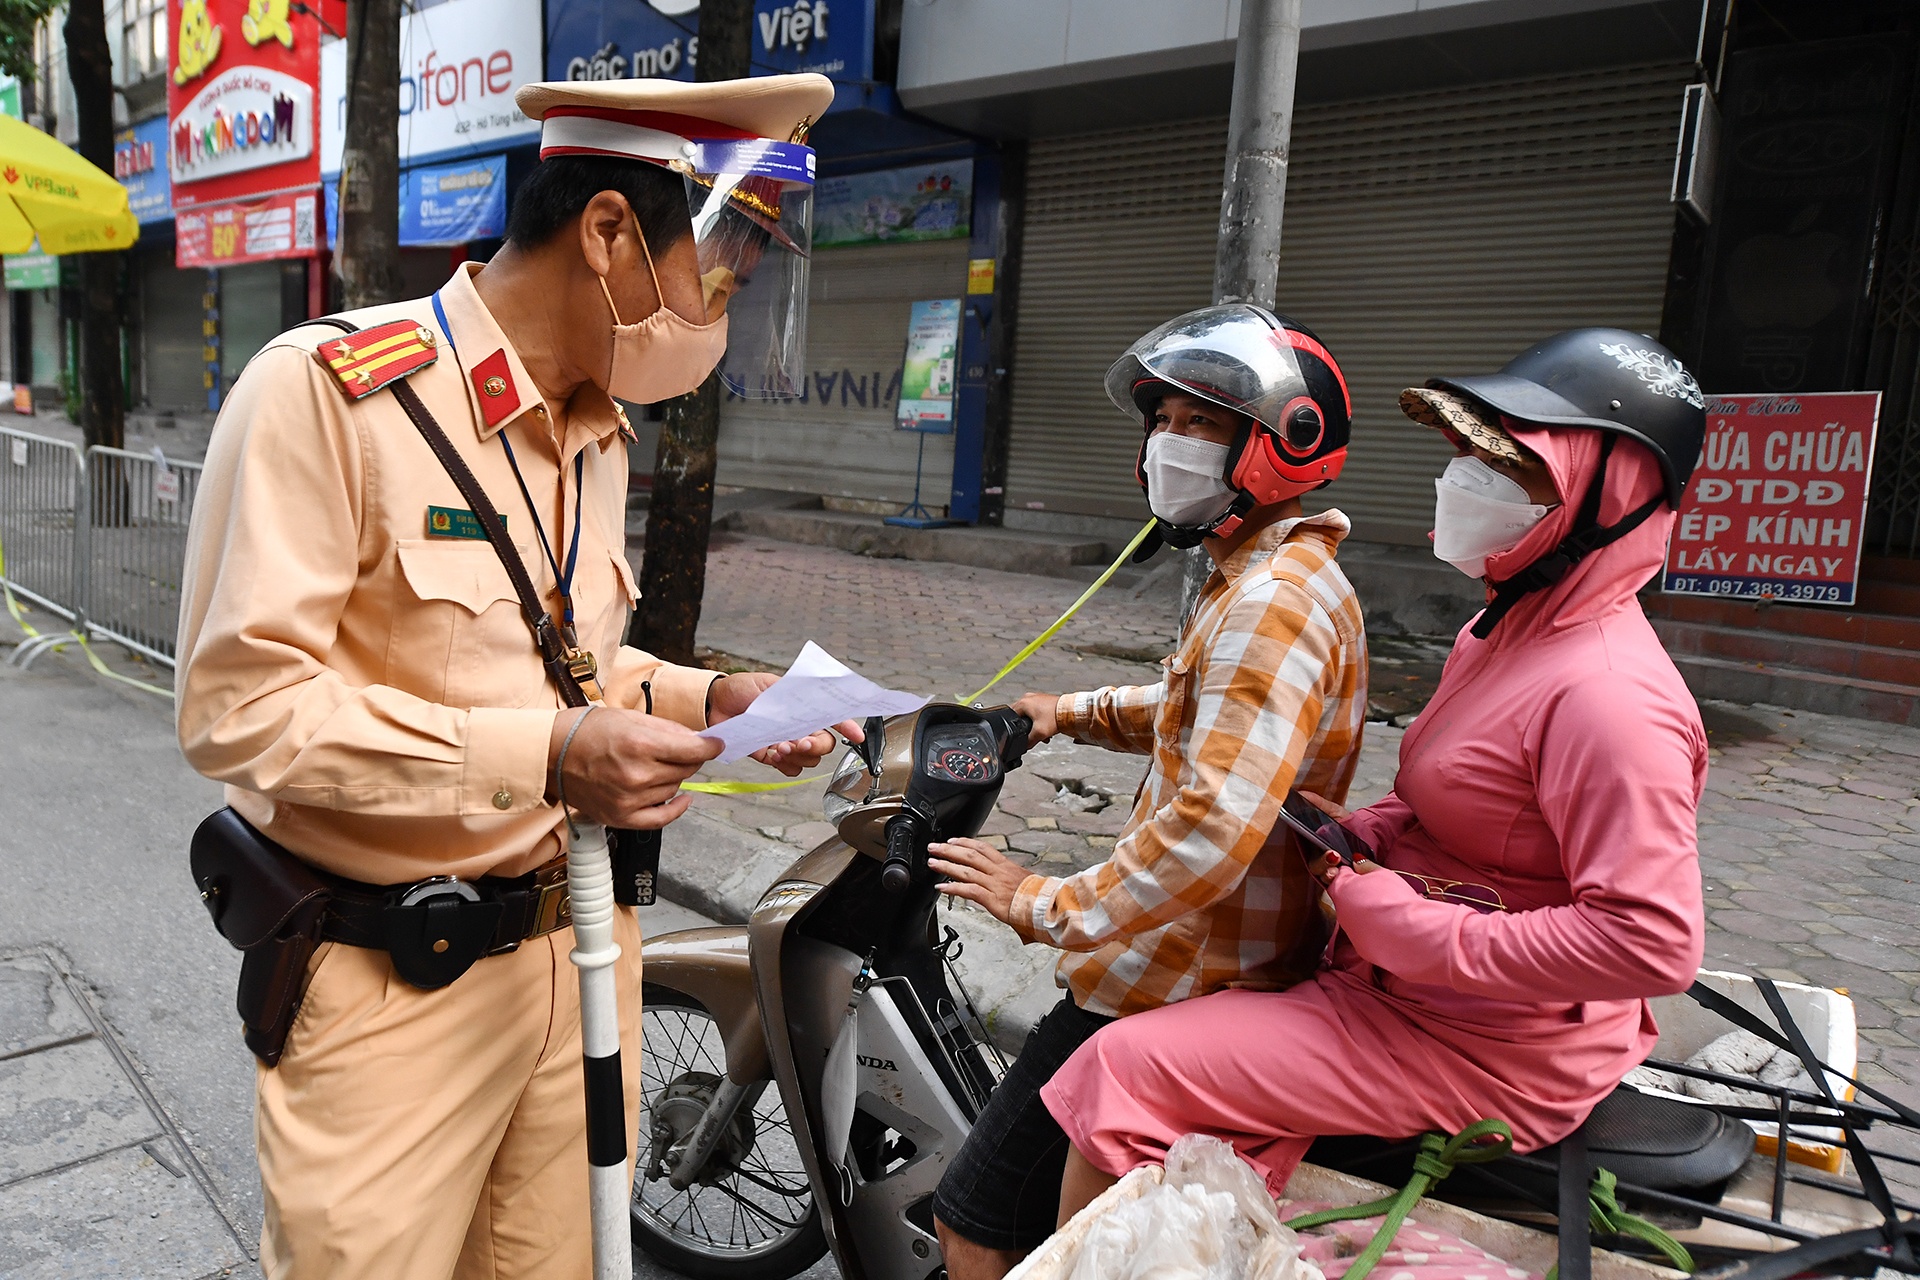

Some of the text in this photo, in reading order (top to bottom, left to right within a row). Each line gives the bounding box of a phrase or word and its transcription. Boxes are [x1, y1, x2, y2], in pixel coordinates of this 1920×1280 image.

[757, 0, 828, 52] Việt
[567, 42, 627, 81] Giấc
[633, 37, 681, 78] mơ
[338, 50, 512, 131] ifone
[24, 172, 79, 199] VPBank
[1764, 421, 1864, 472] CHỮA
[1695, 478, 1845, 505] ĐTDĐ
[1679, 507, 1851, 547] ÉP KÍNH
[1677, 545, 1843, 577] LẤY NGAY
[1675, 577, 1840, 601] ĐT: 097.383.3979
[824, 1048, 898, 1072] NDA
